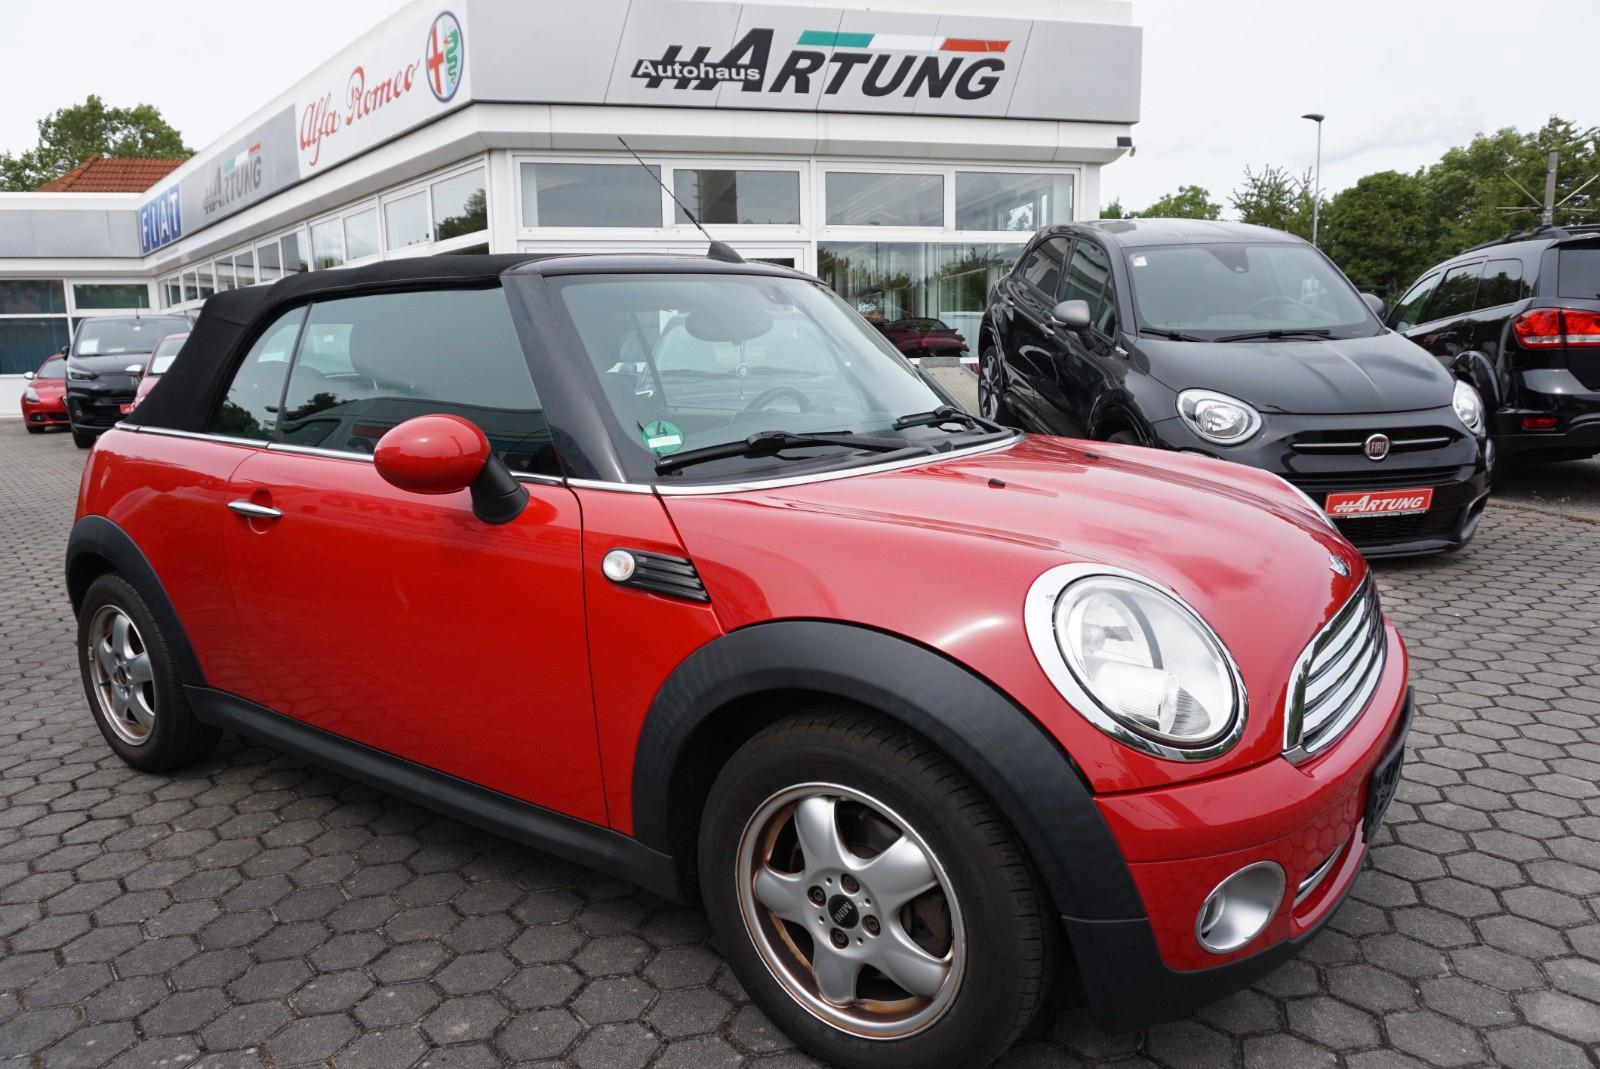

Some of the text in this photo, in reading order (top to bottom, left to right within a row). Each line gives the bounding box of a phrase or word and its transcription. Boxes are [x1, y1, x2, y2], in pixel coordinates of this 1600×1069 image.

[632, 28, 1006, 99] HARTUNG
[637, 59, 760, 81] Autohaus
[299, 59, 420, 167] Alfa Romeo
[141, 192, 179, 246] FIAT
[656, 421, 669, 437] 4
[1371, 441, 1386, 454] FIAT
[1333, 495, 1425, 513] HARTUNG
[834, 901, 853, 922] MINI
